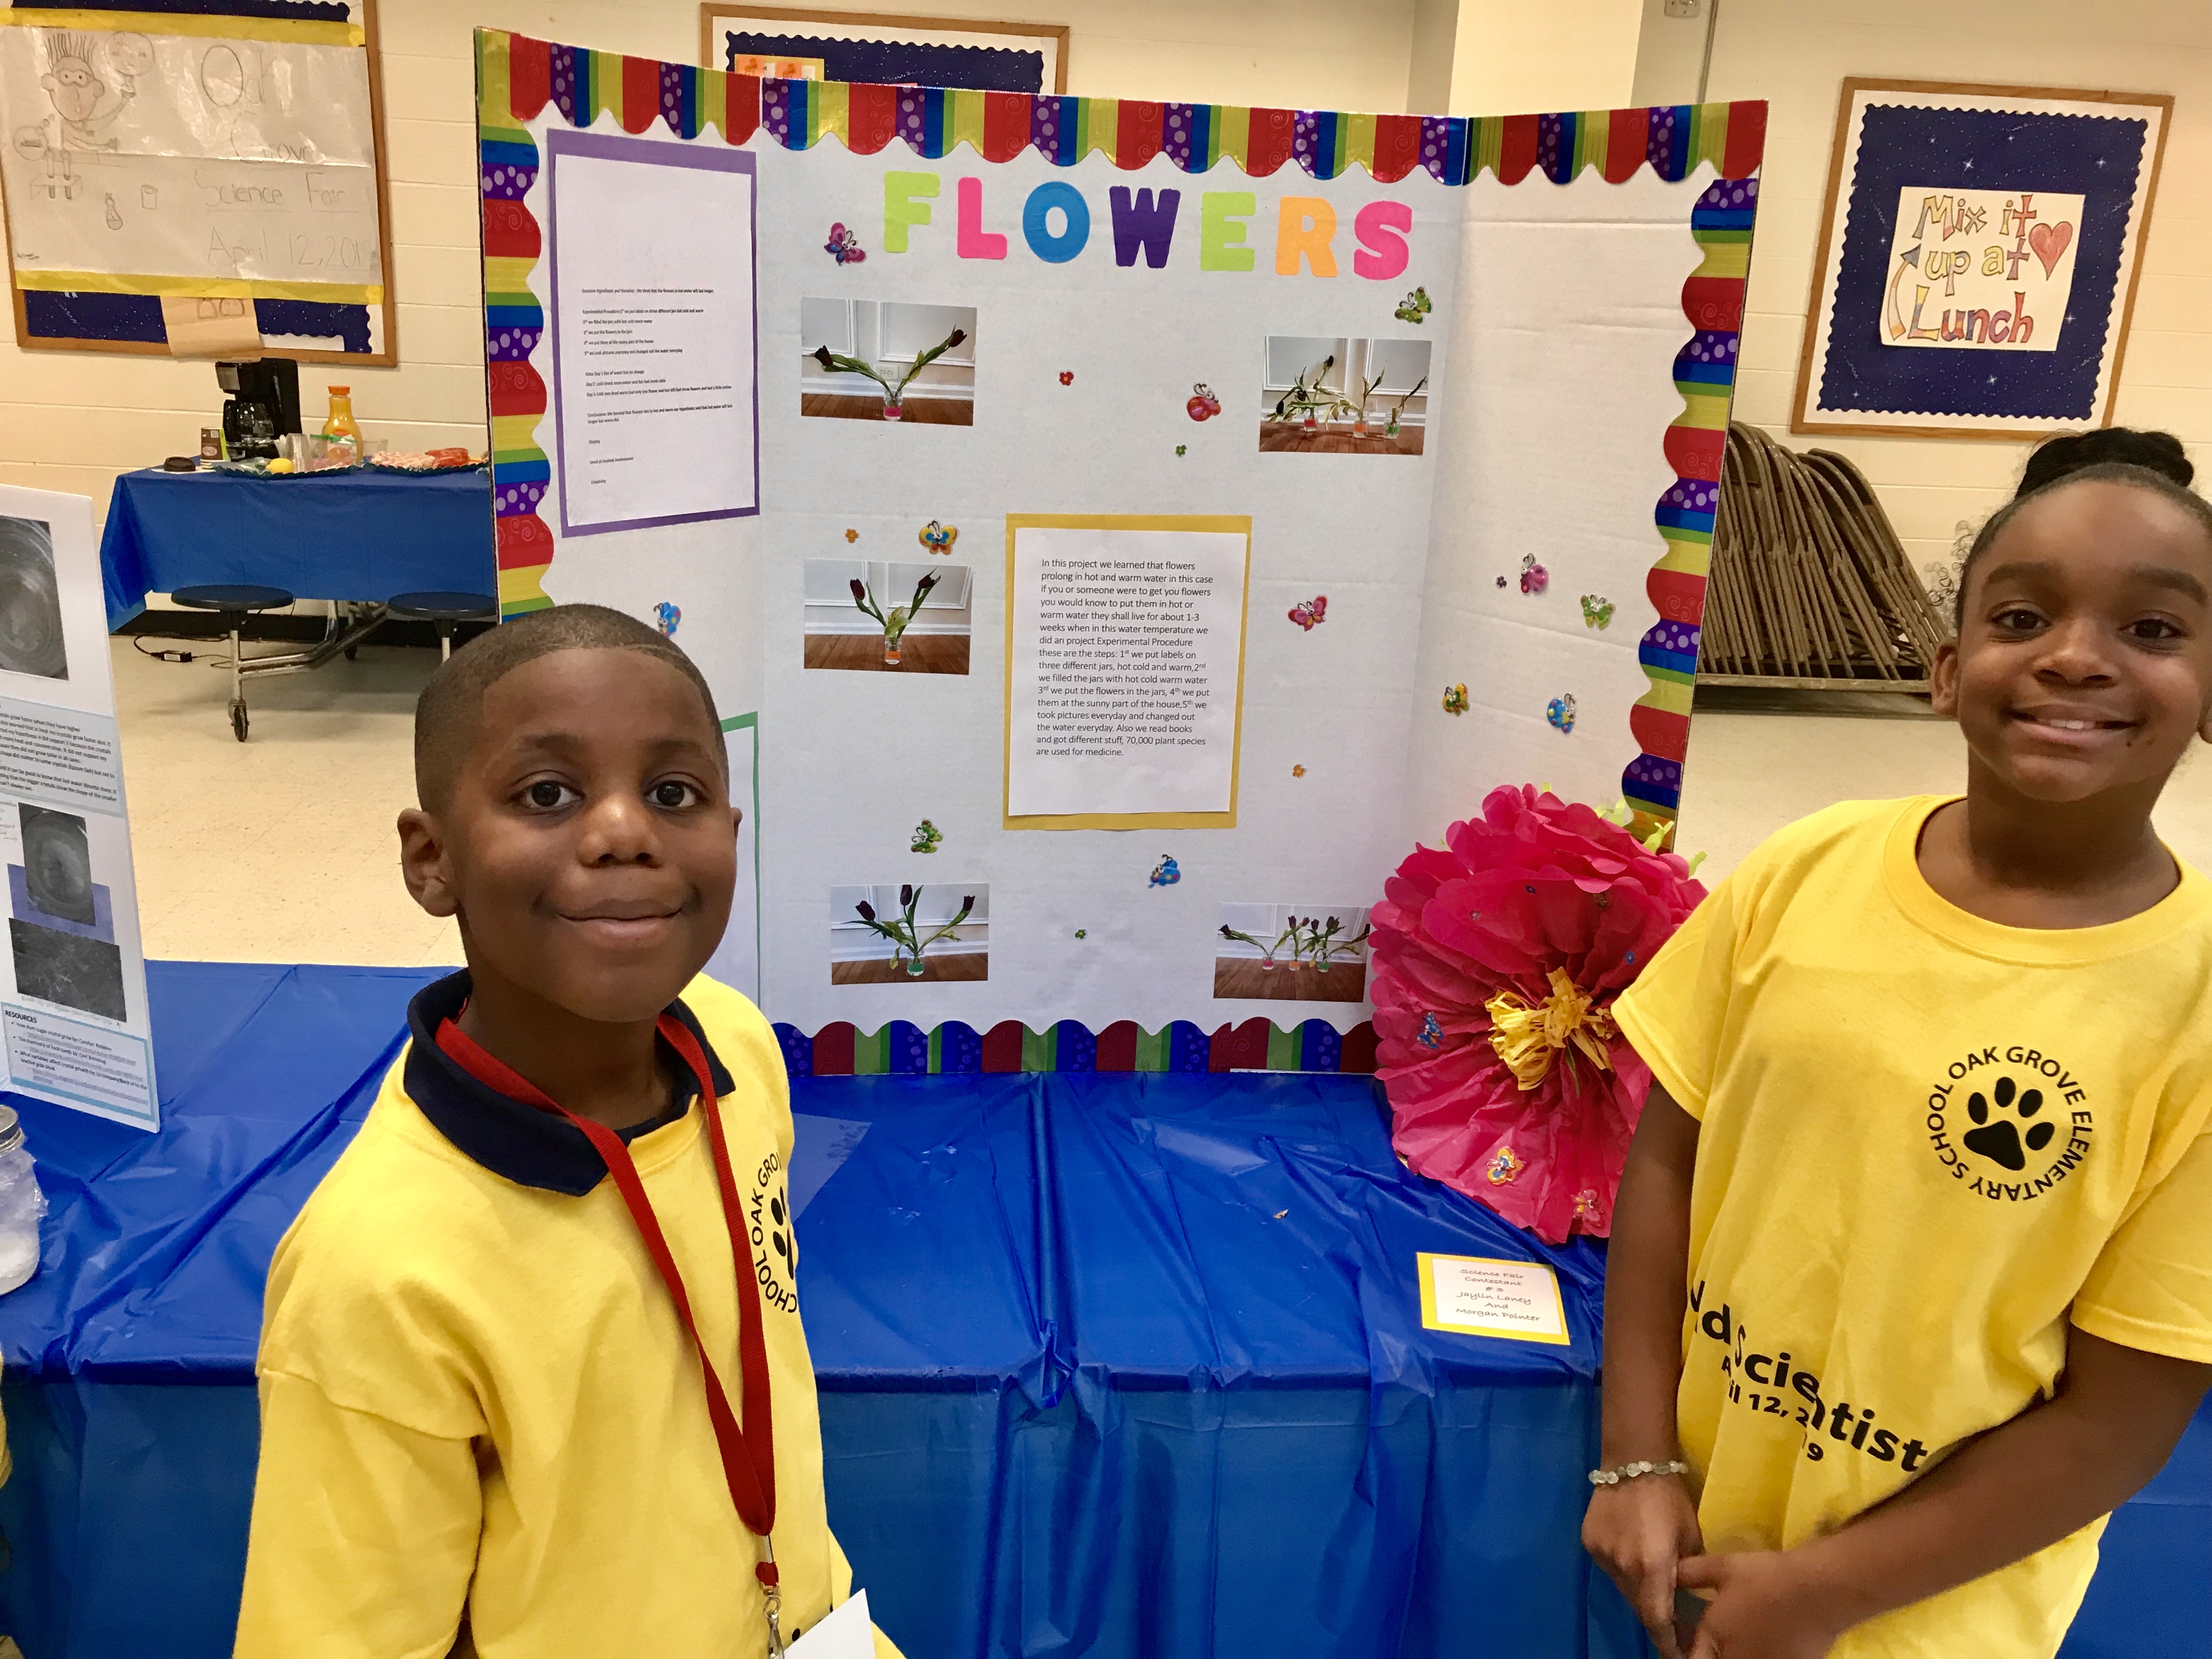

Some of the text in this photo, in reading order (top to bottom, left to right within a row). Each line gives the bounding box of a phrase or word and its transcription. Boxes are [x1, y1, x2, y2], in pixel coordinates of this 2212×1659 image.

[195, 167, 345, 207] Science Fair
[1912, 194, 2036, 241] Mix it
[884, 171, 1412, 281] FLOWERS
[1925, 238, 2030, 296] up at
[1907, 284, 2034, 343] Lunch
[1052, 558, 1066, 567] this
[1068, 560, 1097, 569] project
[1114, 560, 1144, 568] learned
[1147, 561, 1163, 569] that
[1165, 561, 1195, 570] flowers
[1041, 572, 1073, 582] prolong
[1085, 572, 1098, 580] hot
[1101, 573, 1116, 581] and
[1178, 574, 1193, 583] this
[1041, 584, 1047, 592] if
[1149, 588, 1162, 596] get
[1181, 587, 1211, 596] flowers
[1040, 599, 1055, 607] you
[1057, 598, 1082, 606] would
[1085, 598, 1107, 606] know
[1120, 600, 1133, 608] put
[1135, 599, 1157, 607] them
[1159, 600, 1166, 608] in
[1169, 600, 1182, 608] hot
[1091, 611, 1109, 621] they
[1111, 611, 1129, 620] shall
[1131, 612, 1145, 620] live
[1147, 612, 1159, 620] for
[1160, 612, 1184, 621] about
[1187, 613, 1199, 621] 1-3
[1067, 623, 1090, 631] when
[1101, 624, 1116, 632] this
[1143, 625, 1194, 635] temperature
[1039, 635, 1052, 644] did
[1066, 637, 1095, 646] project
[1097, 636, 1149, 646] Experimental
[1152, 637, 1193, 646] Procedure
[1039, 648, 1061, 657] these
[1078, 649, 1092, 657] the
[1094, 650, 1117, 659] steps:
[1145, 651, 1159, 659] put
[1161, 650, 1183, 658] labels
[1039, 661, 1060, 669] three
[1062, 661, 1097, 669] different
[1098, 662, 1115, 672] jars,
[1132, 662, 1149, 670] cold
[1052, 673, 1071, 681] filled
[1074, 674, 1087, 682] the
[1088, 675, 1103, 684] jars
[1105, 674, 1122, 682] with
[1140, 675, 1157, 683] cold
[1080, 686, 1093, 695] the
[1096, 686, 1125, 695] flowers
[1136, 687, 1149, 695] the
[1150, 688, 1167, 697] jars,
[1196, 689, 1210, 697] put
[1070, 698, 1084, 707] the
[1130, 699, 1139, 707] of
[1057, 711, 1089, 720] pictures
[1091, 712, 1127, 721] everyday
[1146, 712, 1180, 721] changed
[1037, 723, 1050, 731] the
[1077, 724, 1114, 733] everyday.
[1116, 724, 1133, 732] Also
[1169, 724, 1192, 732] books
[1053, 736, 1066, 744] got
[1068, 735, 1103, 743] different
[1104, 735, 1123, 744] stuff,
[1126, 736, 1153, 745] 70,000
[1155, 736, 1175, 746] plant
[1177, 737, 1205, 746] species
[5, 1009, 37, 1024] RESOURCES
[1927, 1046, 2093, 1201] OAK GROVE ELEMENTARY SCHOOL
[751, 1152, 782, 1246] OAK GRO
[1459, 1269, 1499, 1277] Science
[755, 1249, 797, 1313] CHOOL
[1465, 1277, 1522, 1286] Contestant
[1455, 1291, 1531, 1305] Jaylin Laney
[1456, 1308, 1541, 1321] Morgan Pointer
[1748, 1393, 1788, 1418] 12,
